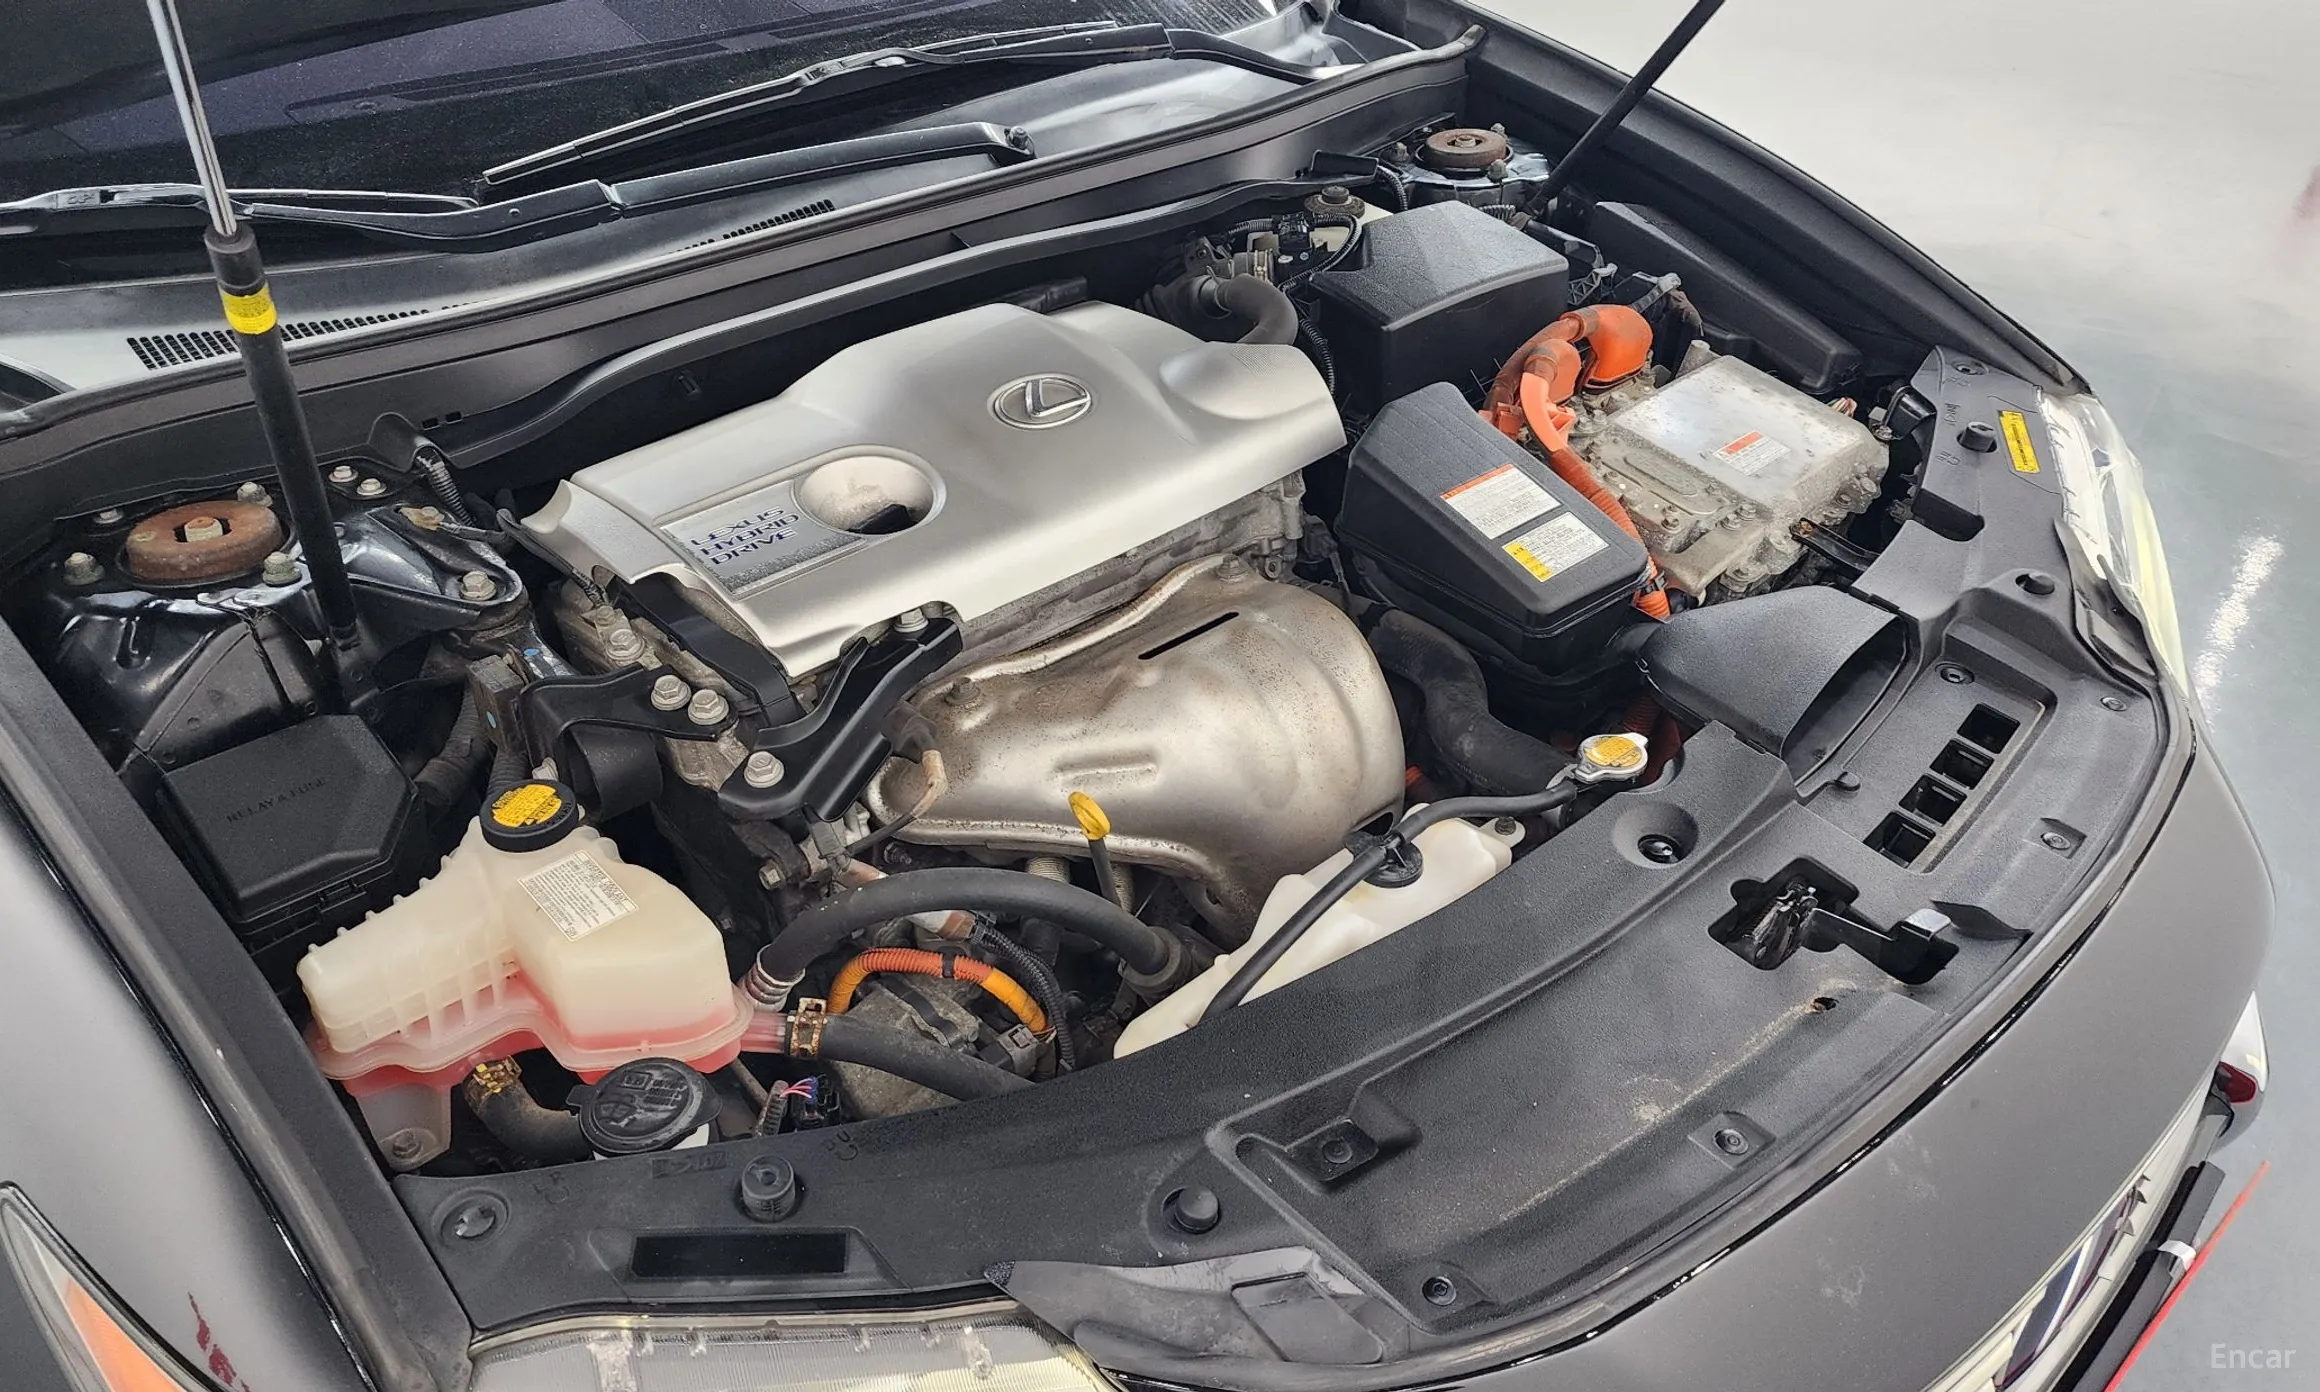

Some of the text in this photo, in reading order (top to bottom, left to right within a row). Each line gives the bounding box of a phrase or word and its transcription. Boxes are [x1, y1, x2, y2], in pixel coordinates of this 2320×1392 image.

[691, 505, 786, 546] LEXUS
[698, 513, 800, 556] HYBRID
[708, 527, 797, 565] DRIVE
